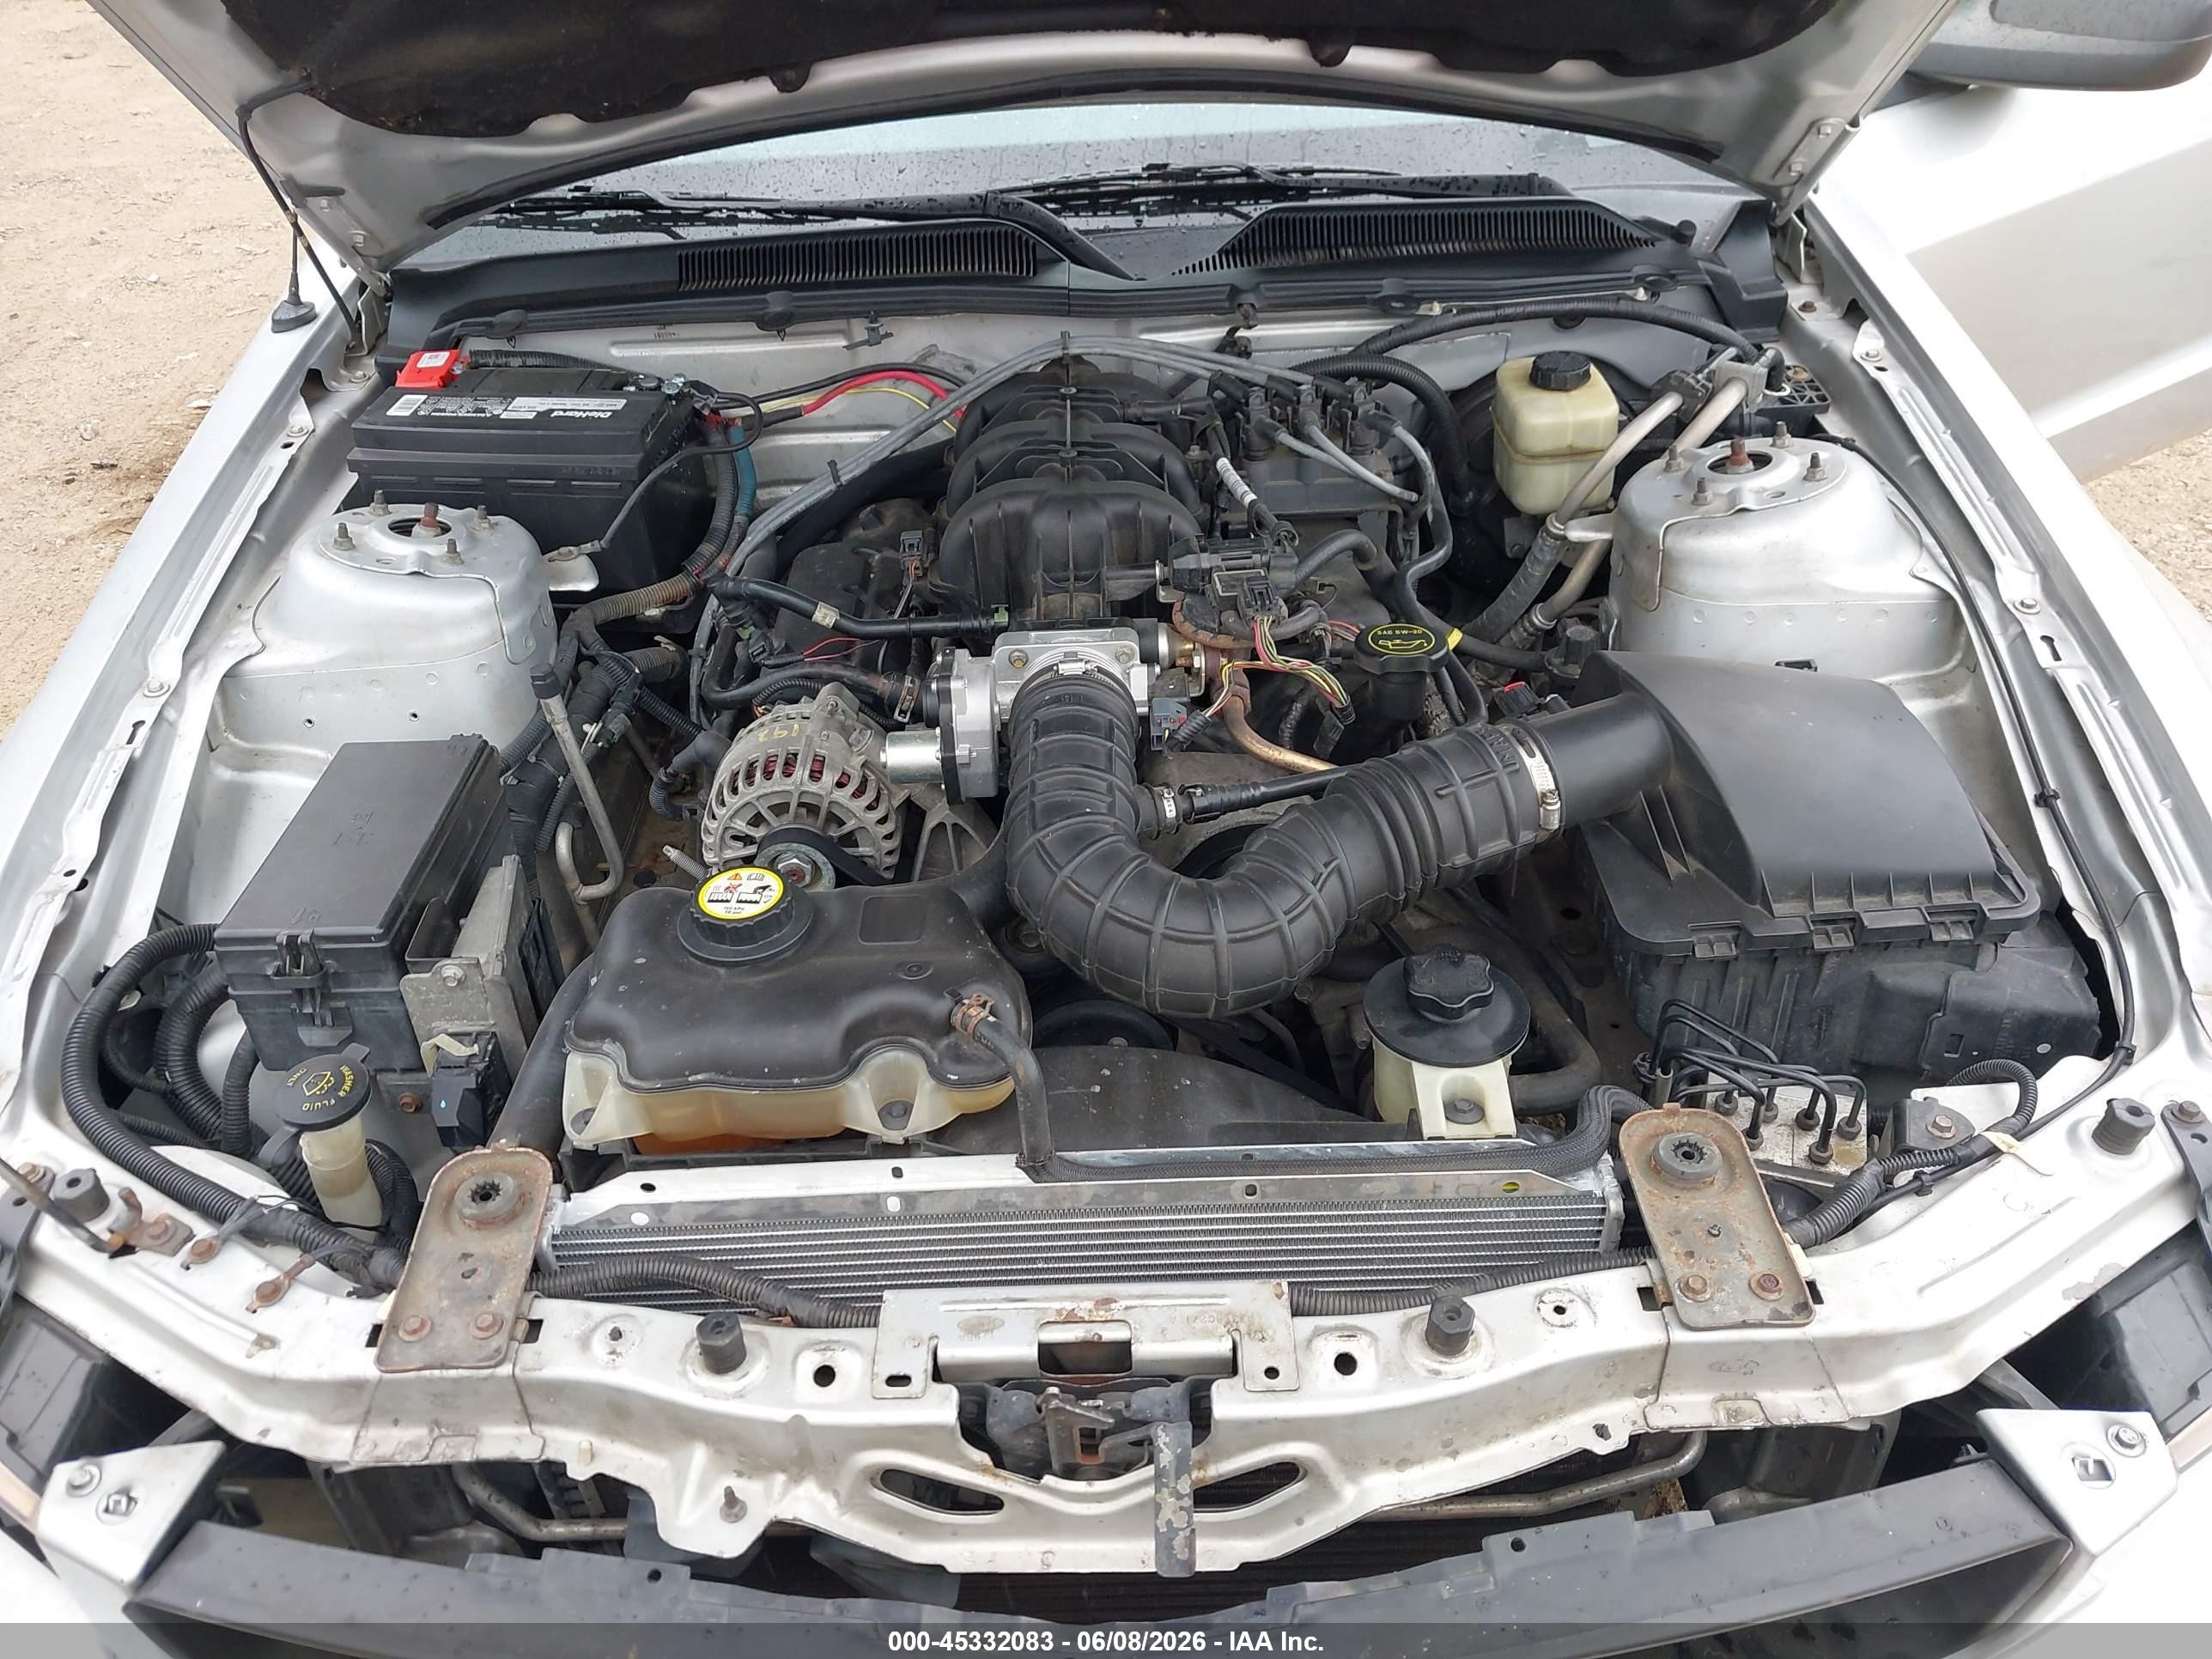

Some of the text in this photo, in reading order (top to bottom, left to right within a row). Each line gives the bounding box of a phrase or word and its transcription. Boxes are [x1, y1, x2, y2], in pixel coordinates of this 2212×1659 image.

[550, 410, 612, 419] DieHard
[338, 1064, 355, 1097] WASHER
[302, 1097, 336, 1111] FLUID
